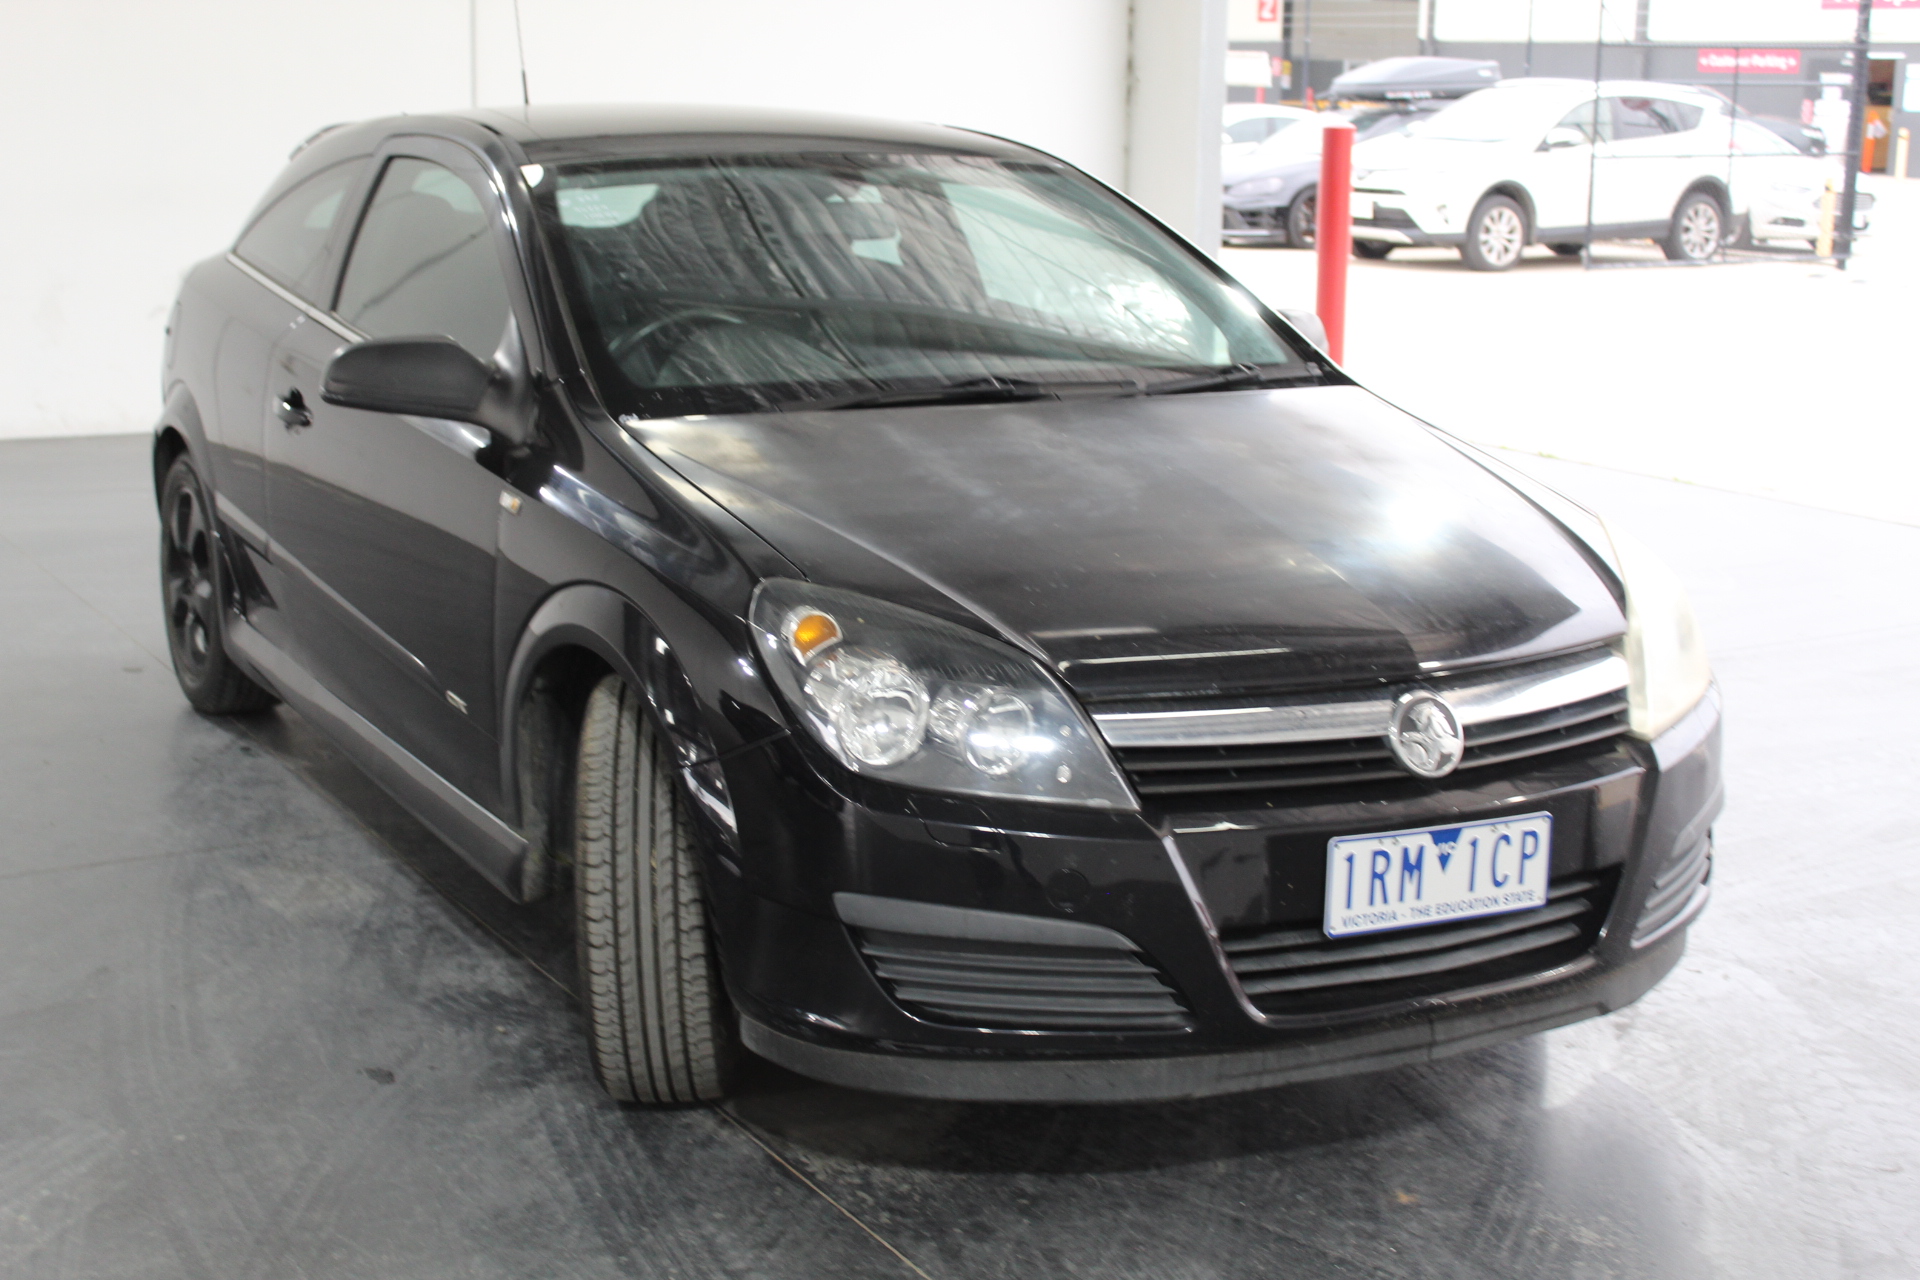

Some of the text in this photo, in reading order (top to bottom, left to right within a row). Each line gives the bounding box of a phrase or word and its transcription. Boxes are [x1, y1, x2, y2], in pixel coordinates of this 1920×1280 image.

[1344, 830, 1539, 910] 1RM 1CP
[1341, 910, 1399, 928] VICTORIA
[1410, 904, 1432, 919] THE
[1435, 896, 1500, 915] EDUCATION
[1503, 889, 1535, 905] STATE
